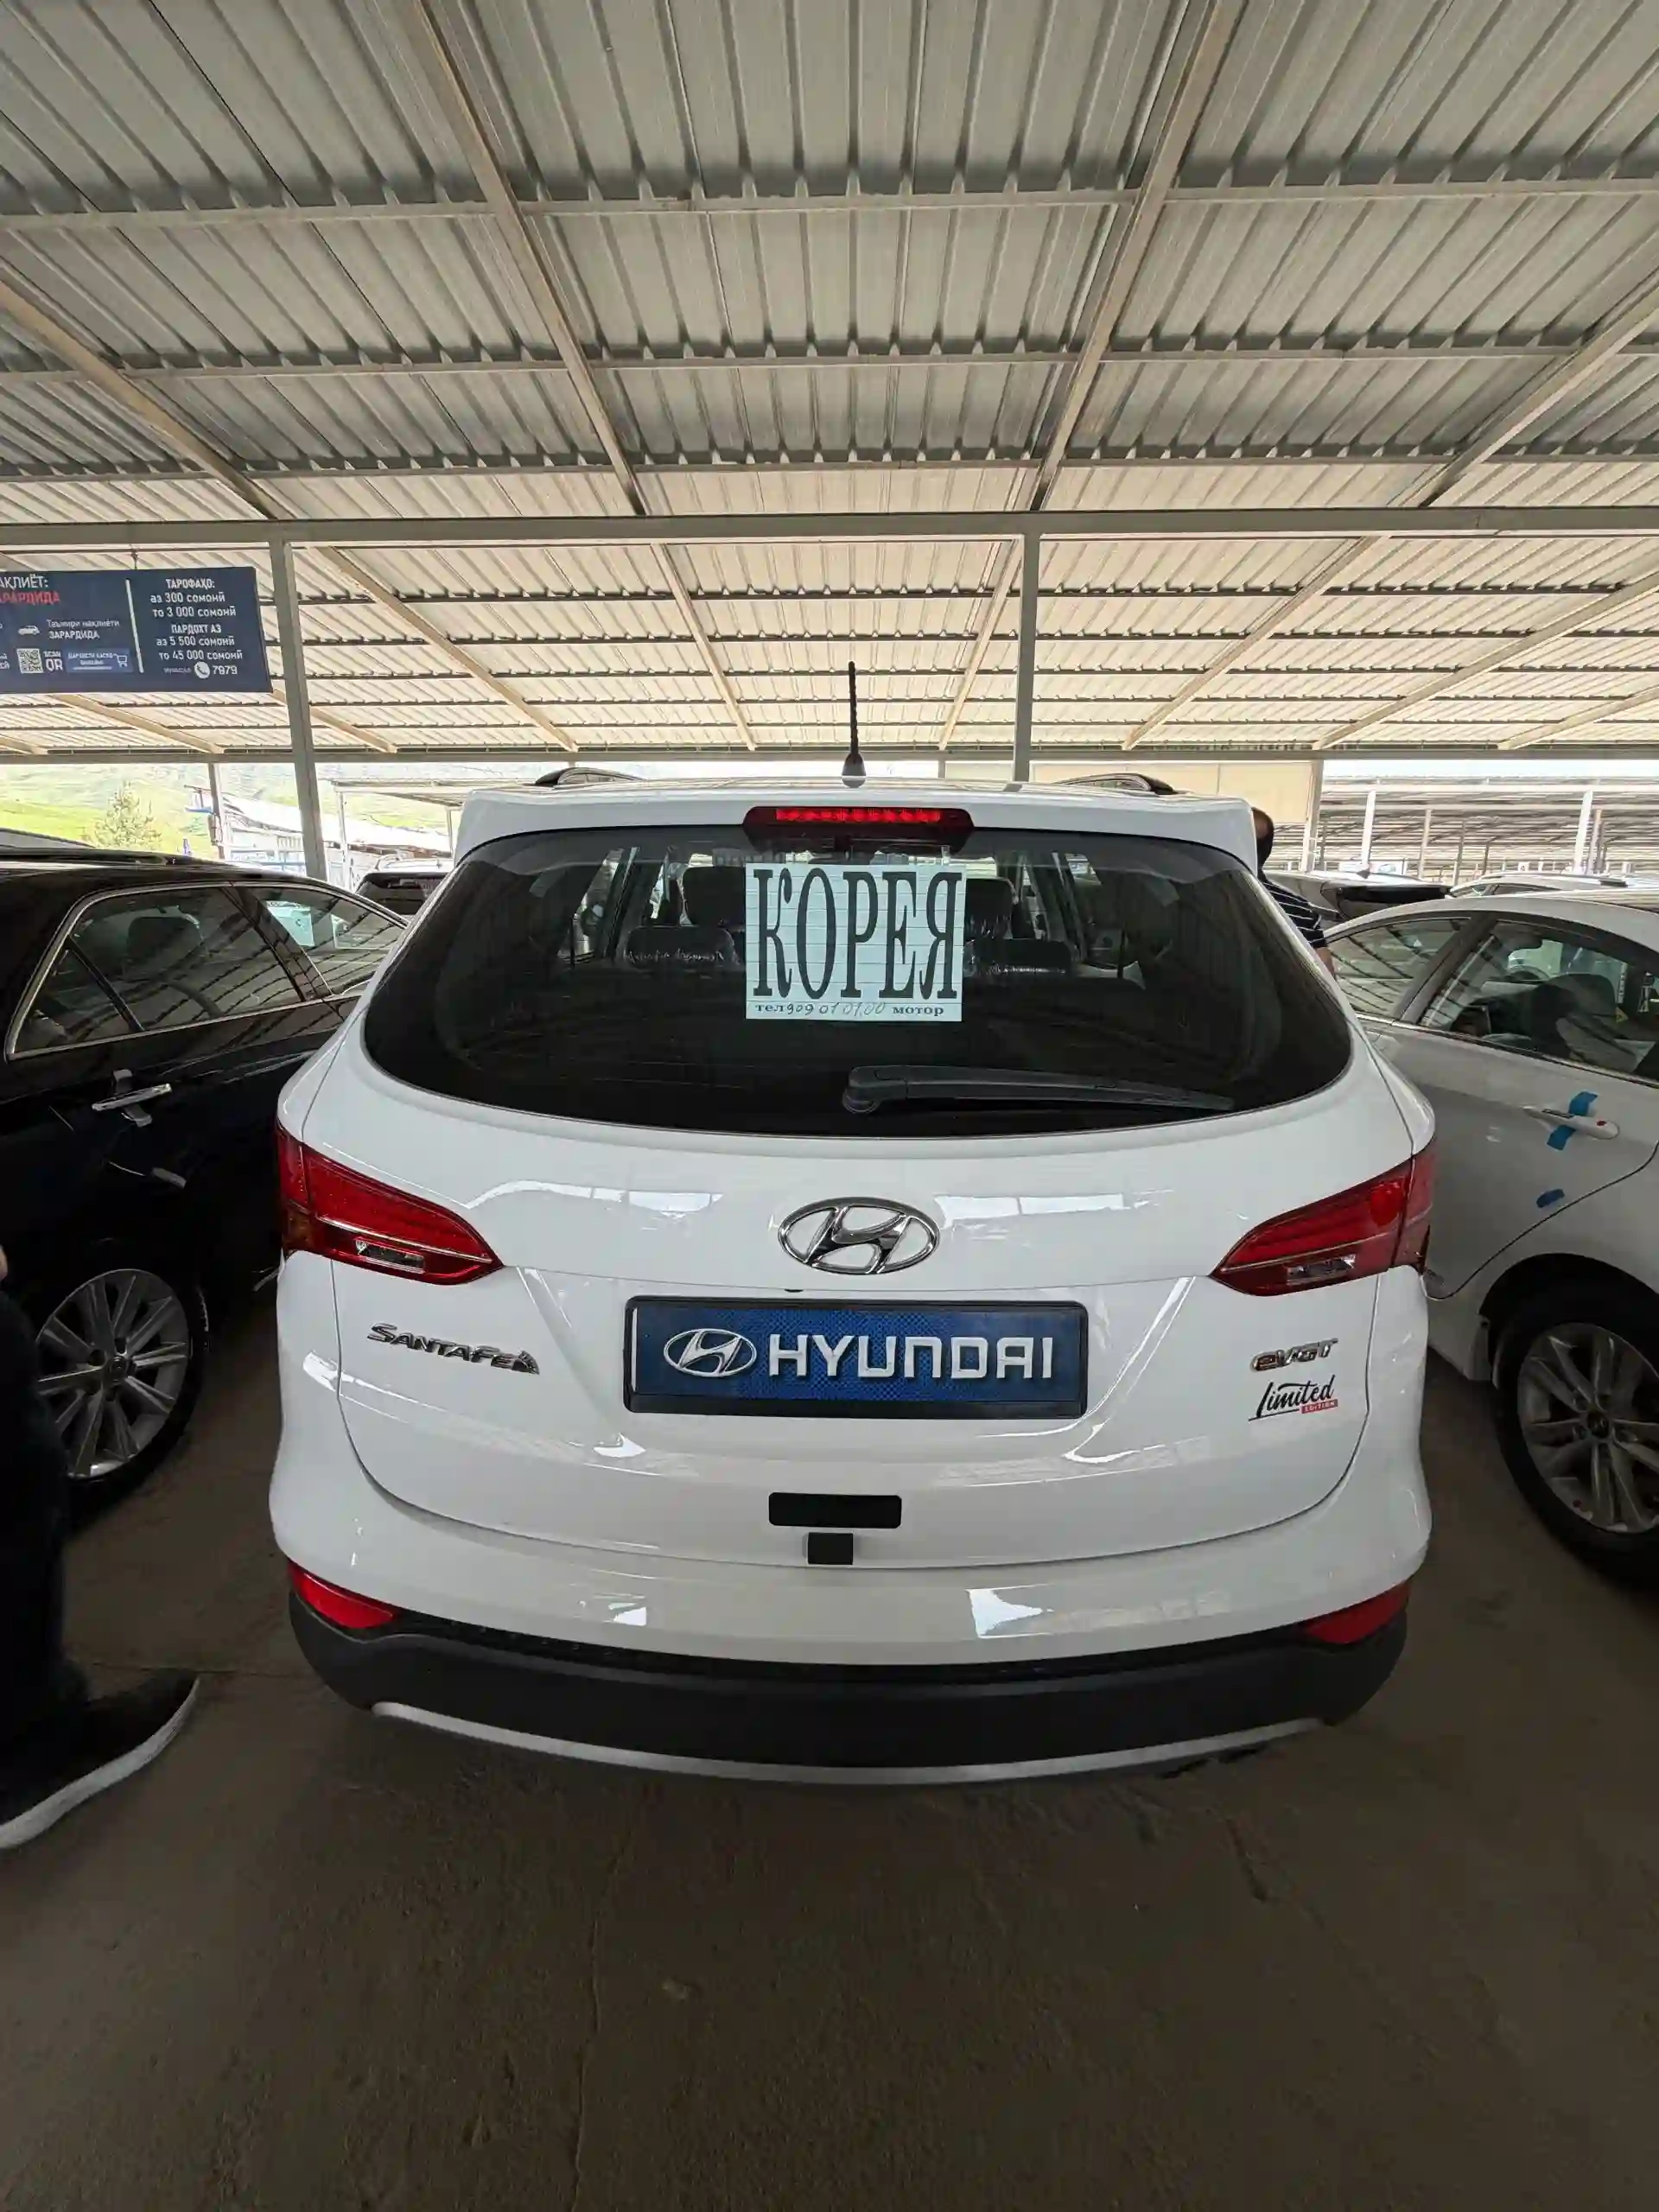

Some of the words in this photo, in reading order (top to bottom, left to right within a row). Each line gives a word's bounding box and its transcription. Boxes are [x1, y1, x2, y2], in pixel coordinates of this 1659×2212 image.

[150, 594, 162, 603] аз
[164, 592, 184, 603] 300
[167, 607, 174, 617] 3
[176, 607, 194, 617] 000
[171, 624, 208, 634] ПАРДОХТ
[211, 624, 222, 633] АЗ
[48, 631, 100, 639] ЗАРАРДИДА
[156, 638, 168, 646] аз
[170, 636, 176, 646] 5
[178, 636, 196, 646] 500
[159, 652, 170, 660] то
[172, 650, 184, 660] 45
[187, 650, 205, 660] 000
[46, 658, 63, 671] QR
[753, 868, 962, 1000] КОРЕЯ
[892, 1005, 944, 1017] мотор
[768, 1333, 1053, 1379] HYUNDAI
